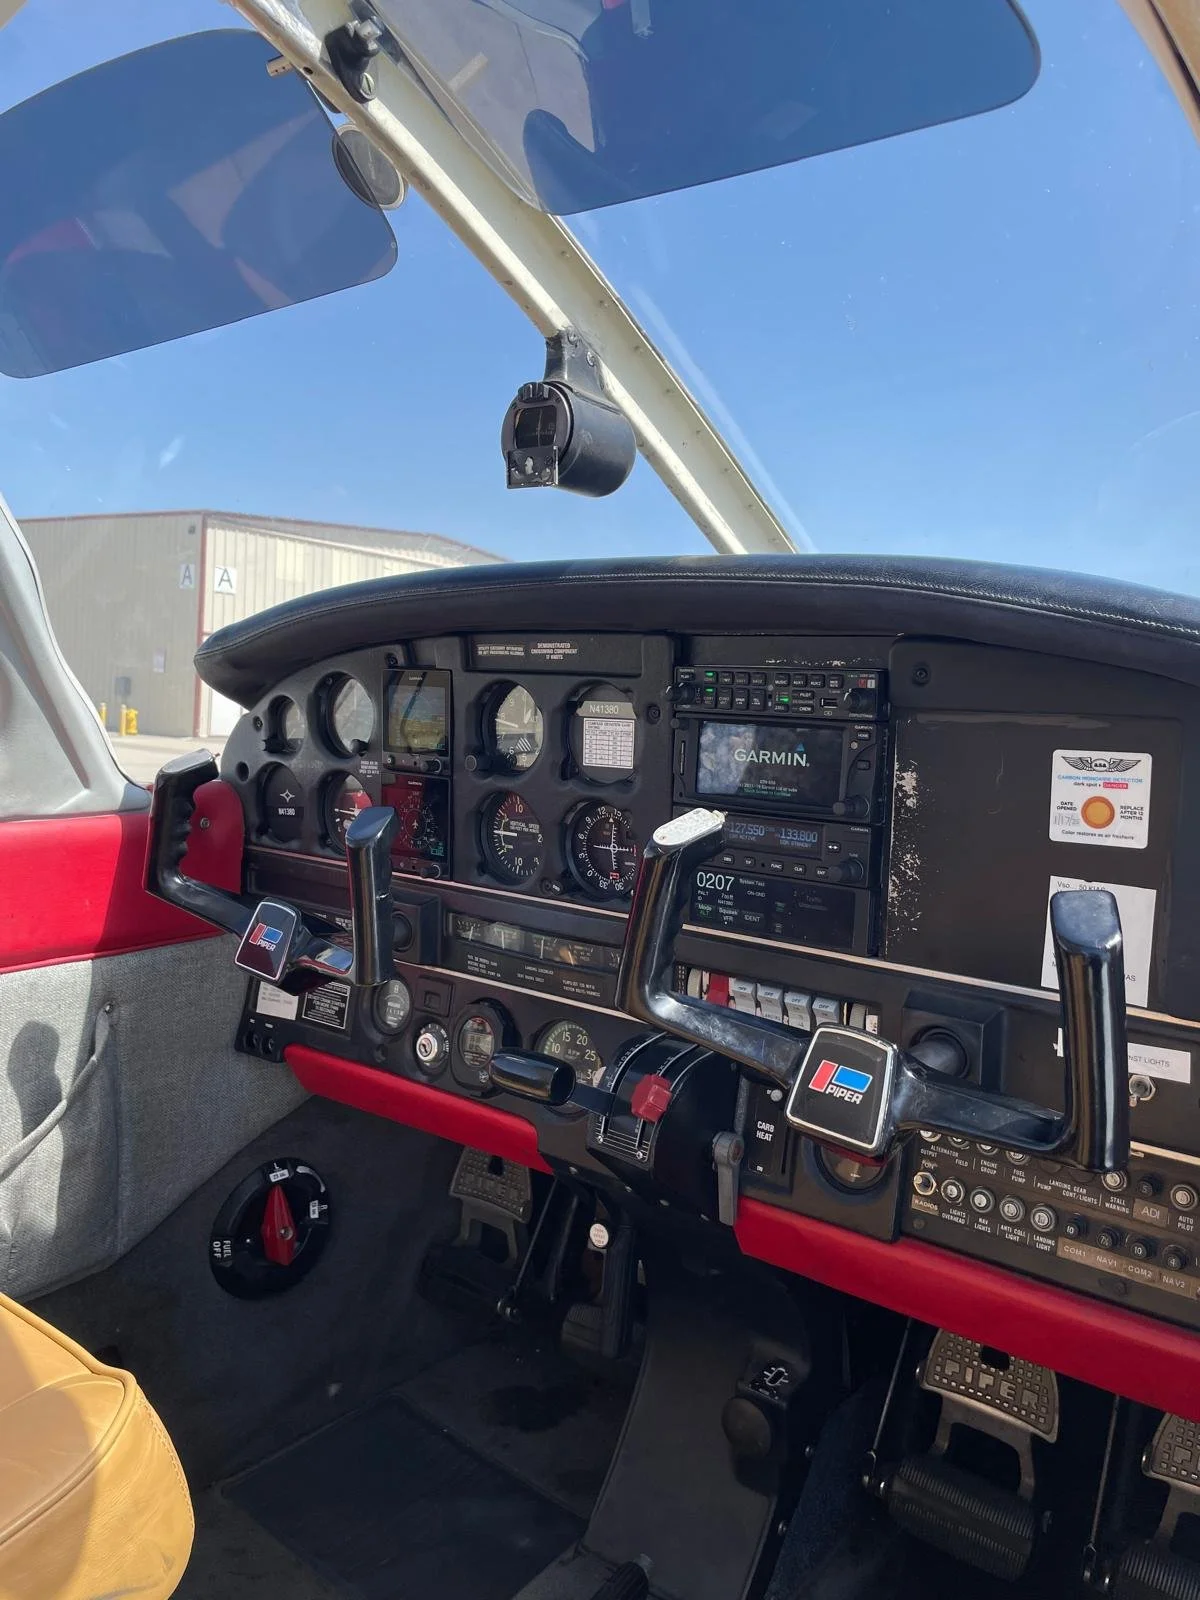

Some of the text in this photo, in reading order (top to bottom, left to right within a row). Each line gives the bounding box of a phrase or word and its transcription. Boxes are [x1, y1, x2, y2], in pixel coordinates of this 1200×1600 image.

[181, 564, 192, 585] A
[218, 567, 233, 589] A
[734, 748, 807, 767] GARMIN
[515, 804, 524, 814] 10
[598, 806, 607, 815] 12
[585, 816, 592, 824] 9
[729, 822, 765, 837] 127.550
[780, 828, 818, 843] 133.800
[537, 834, 543, 843] 2
[514, 857, 523, 866] 10
[696, 871, 735, 891] 0207
[744, 914, 761, 922] IDENT
[256, 938, 277, 952] PIPER
[562, 1031, 571, 1042] 15
[576, 1034, 588, 1046] 20
[551, 1043, 560, 1053] 10
[585, 1049, 596, 1061] 25
[1144, 1058, 1170, 1068] LIGHTS
[826, 1084, 863, 1105] PIPER
[757, 1121, 774, 1132] CARB
[756, 1130, 773, 1142] HEAT
[920, 1148, 938, 1158] OUTPUT
[930, 1144, 959, 1158] ALTERNATOR
[955, 1158, 969, 1167] FIELD
[980, 1160, 998, 1169] ENGINE
[980, 1167, 997, 1176] GROUP
[1013, 1169, 1025, 1177] FUEL
[1011, 1175, 1026, 1184] PUMP
[1037, 1182, 1052, 1191] PUMP
[1049, 1179, 1087, 1194] LANDING GEAR
[1062, 1190, 1098, 1205] CONT/LIGHTS
[1110, 1196, 1126, 1205] STALL
[914, 1199, 939, 1211] RADIOS
[1105, 1202, 1130, 1214] WARNING
[941, 1213, 966, 1225] OVERHEAD
[949, 1208, 966, 1218] LIGHTS
[1141, 1206, 1160, 1220] ADI
[1178, 1215, 1194, 1225] AUTO
[974, 1224, 991, 1233] LIGHTS
[1000, 1225, 1012, 1233] ANTI
[1177, 1222, 1195, 1232] PILOT
[1005, 1233, 1020, 1242] LIGHT
[1033, 1234, 1055, 1246] LANDING
[213, 1240, 221, 1259] OFF
[223, 1240, 231, 1258] FUEL
[1036, 1242, 1051, 1252] LIGHT
[1063, 1245, 1087, 1258] COM1
[1096, 1254, 1118, 1268] NAV1
[1128, 1264, 1153, 1278] COM2
[1162, 1275, 1185, 1288] NAV2
[944, 1357, 1040, 1410] PIPER
